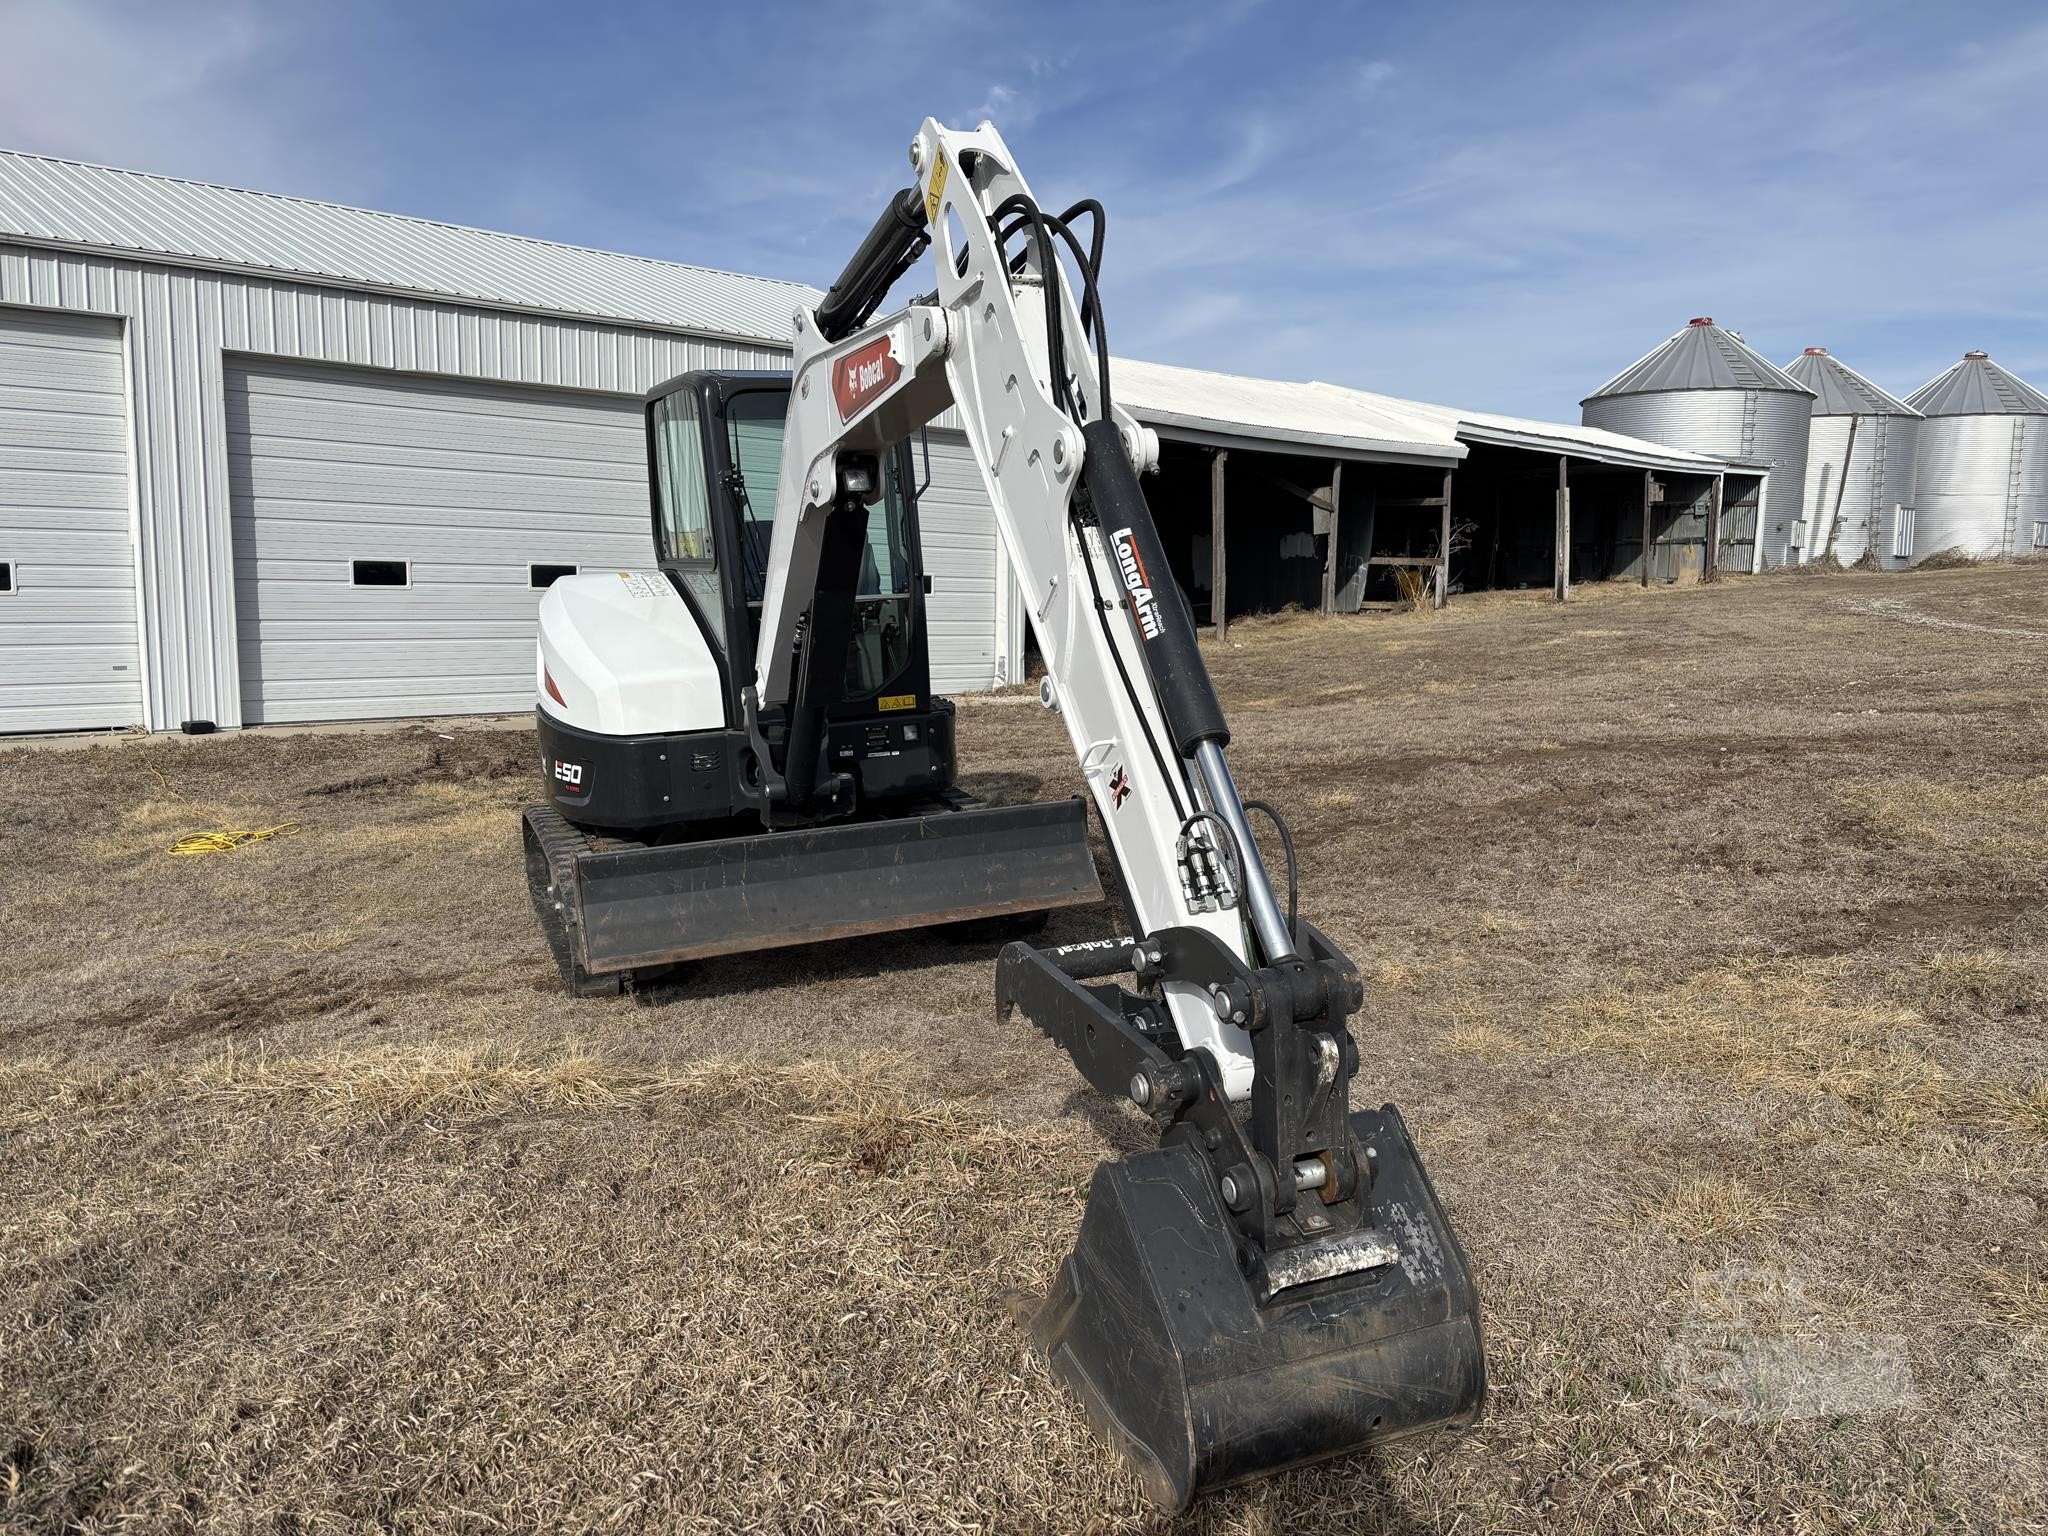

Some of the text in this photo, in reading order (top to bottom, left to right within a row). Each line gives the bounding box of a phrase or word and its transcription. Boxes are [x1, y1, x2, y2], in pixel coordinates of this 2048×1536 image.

[859, 353, 885, 392] Bobcat
[1110, 527, 1158, 639] LongArm
[555, 760, 582, 784] E50
